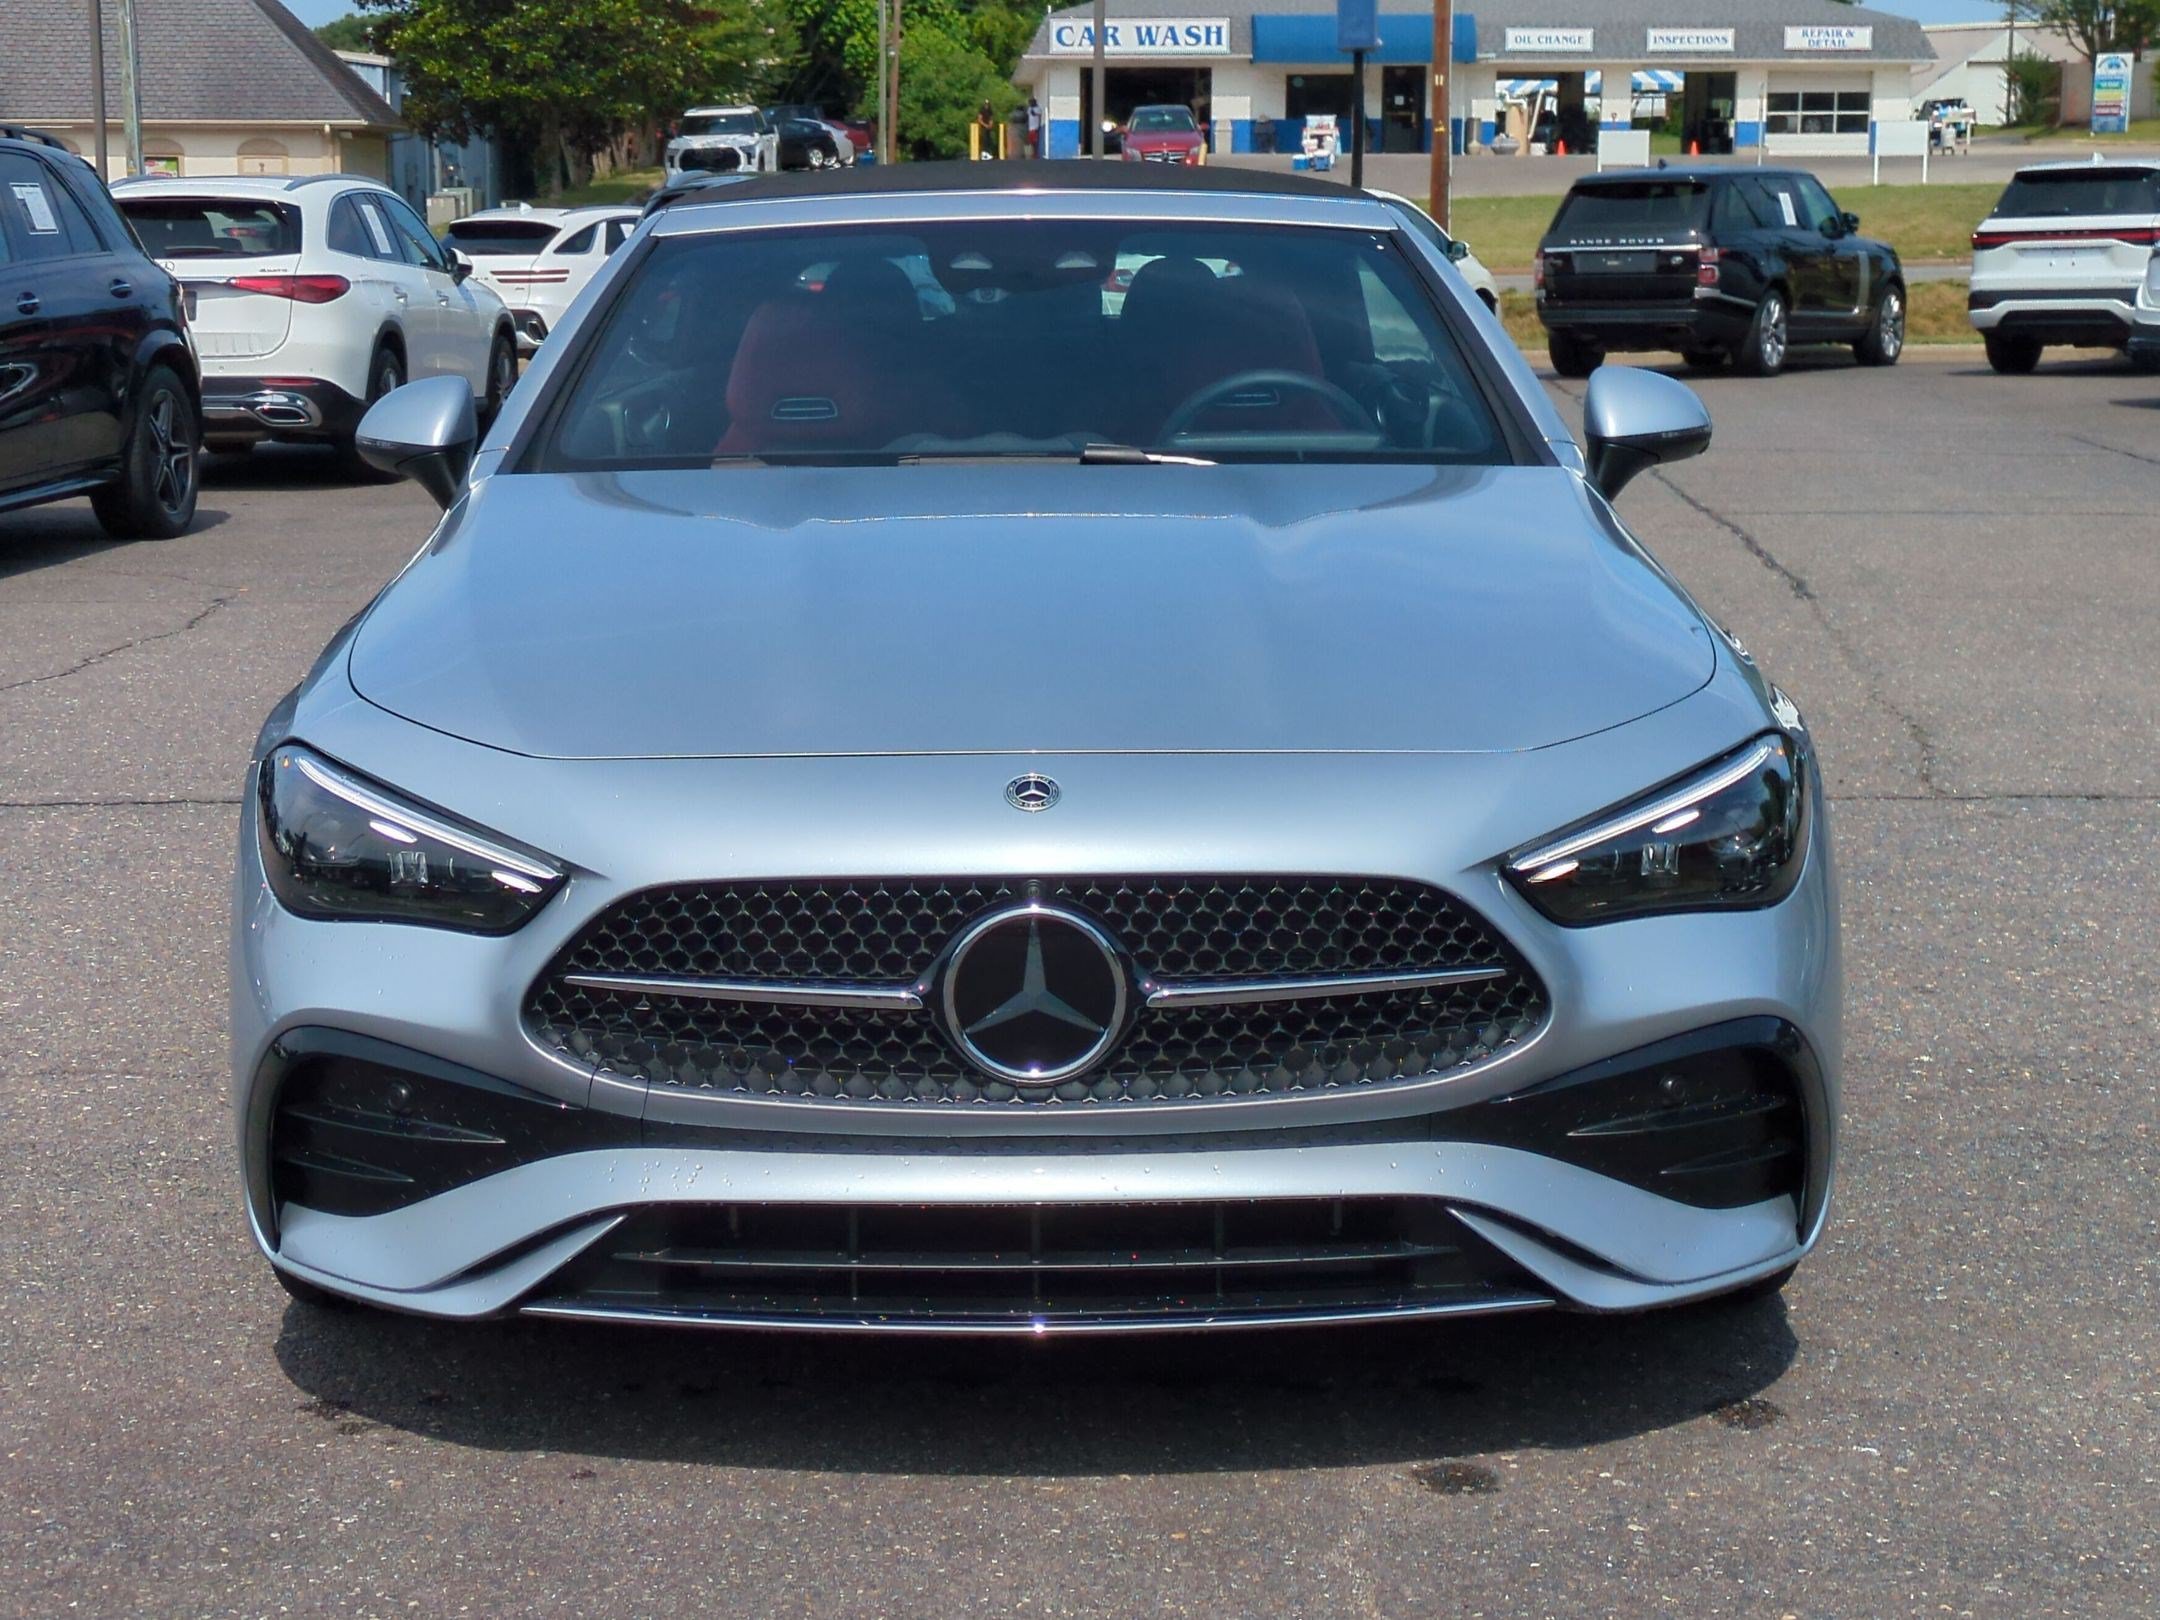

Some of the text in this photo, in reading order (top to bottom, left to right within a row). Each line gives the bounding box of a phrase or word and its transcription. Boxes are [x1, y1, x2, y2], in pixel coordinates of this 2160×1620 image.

[1056, 25, 1223, 46] CAR WASH
[1801, 29, 1842, 37] REPAIR
[1515, 35, 1584, 44] OIL CHANGE
[1653, 35, 1728, 44] INSPECTIONS
[1808, 39, 1846, 47] DETAIL
